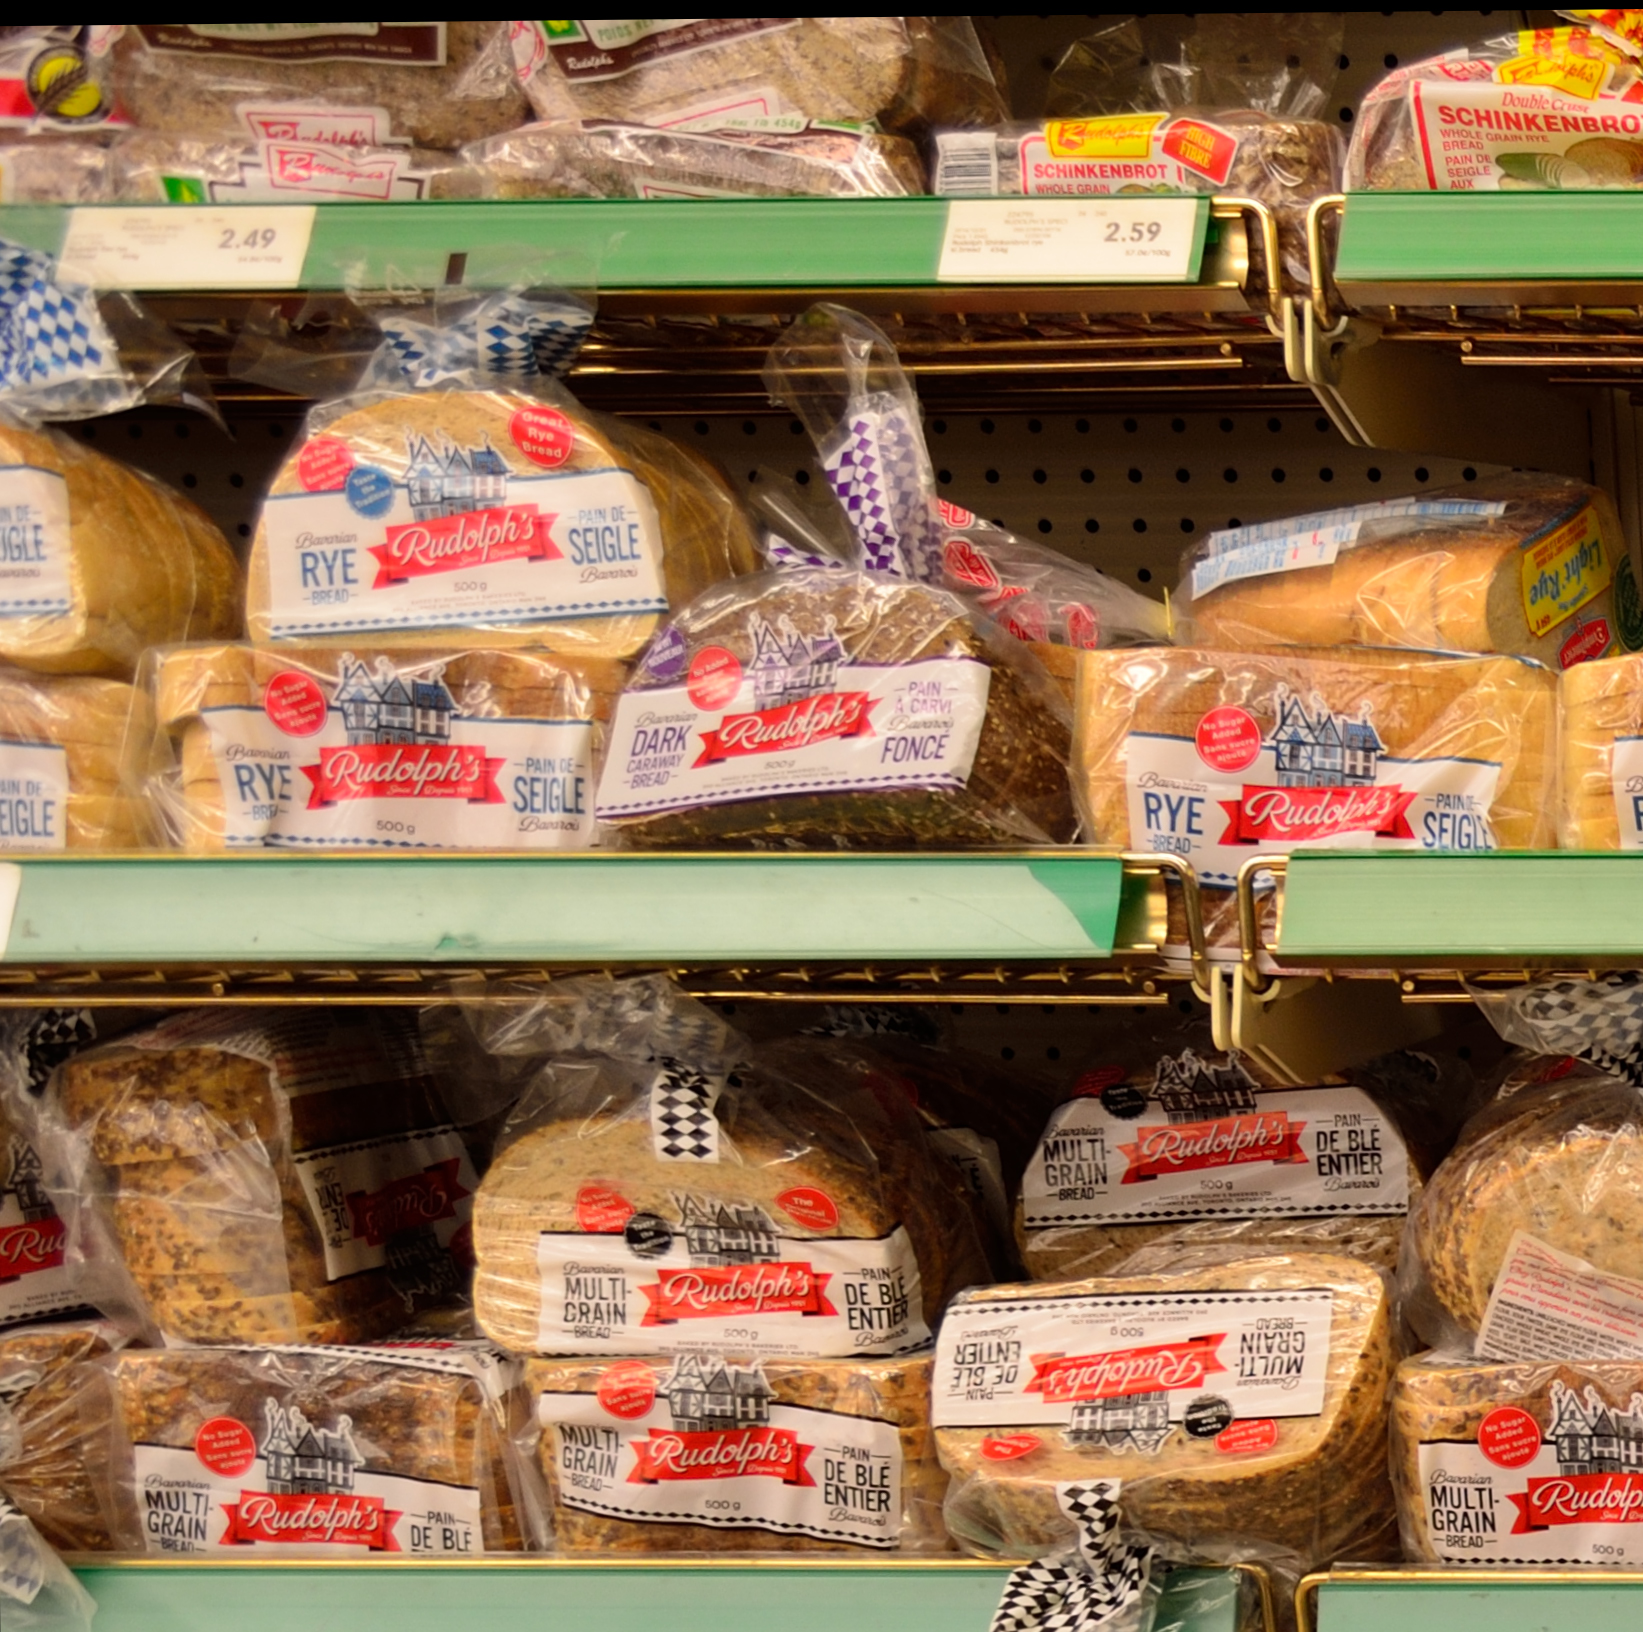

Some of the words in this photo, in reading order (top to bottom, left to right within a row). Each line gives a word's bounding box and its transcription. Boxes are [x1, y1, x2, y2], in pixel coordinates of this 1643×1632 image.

[1502, 90, 1545, 110] Double
[1549, 97, 1590, 114] Crust
[1034, 163, 1168, 181] SCHINKENBROT
[219, 229, 275, 250] 2.49
[1104, 222, 1161, 243] 2.59
[578, 508, 605, 526] PAIN
[609, 505, 627, 523] DE
[391, 514, 536, 567] Rudolph's
[570, 524, 641, 564] SEIGLE
[300, 551, 358, 587] RYE
[631, 726, 691, 757] DARK
[881, 732, 948, 764] FONCÉ
[326, 746, 480, 796] Rudolph's
[625, 755, 685, 775] CARAWAY
[512, 775, 586, 815] SEIGLE
[1246, 789, 1394, 836] Rudolph's
[1143, 1121, 1285, 1167] Rudolph's
[1316, 1130, 1343, 1152] DE
[1348, 1123, 1381, 1151] BLÉ
[1317, 1152, 1383, 1177] ENTIER
[664, 1267, 810, 1307] Rudolph's
[238, 1497, 379, 1538] Rudolph's
